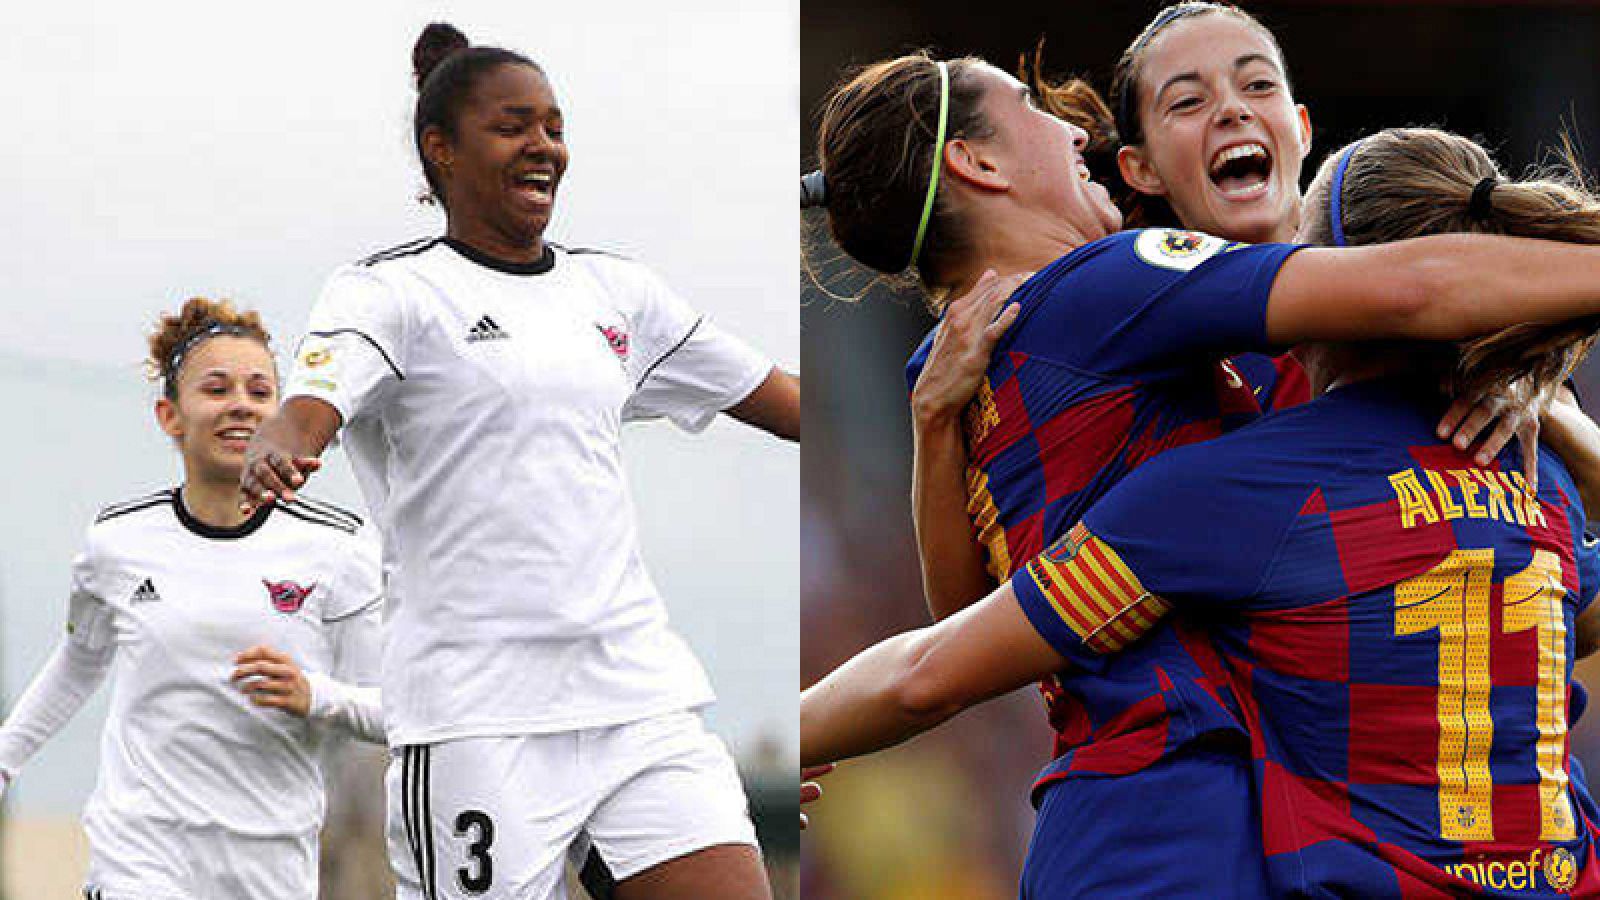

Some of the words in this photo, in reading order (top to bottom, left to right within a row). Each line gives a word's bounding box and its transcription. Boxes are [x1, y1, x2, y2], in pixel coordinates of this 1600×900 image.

[1387, 467, 1549, 529] ALEXIA
[1394, 547, 1579, 841] 11
[453, 809, 494, 897] 3
[1444, 848, 1542, 891] nicef
